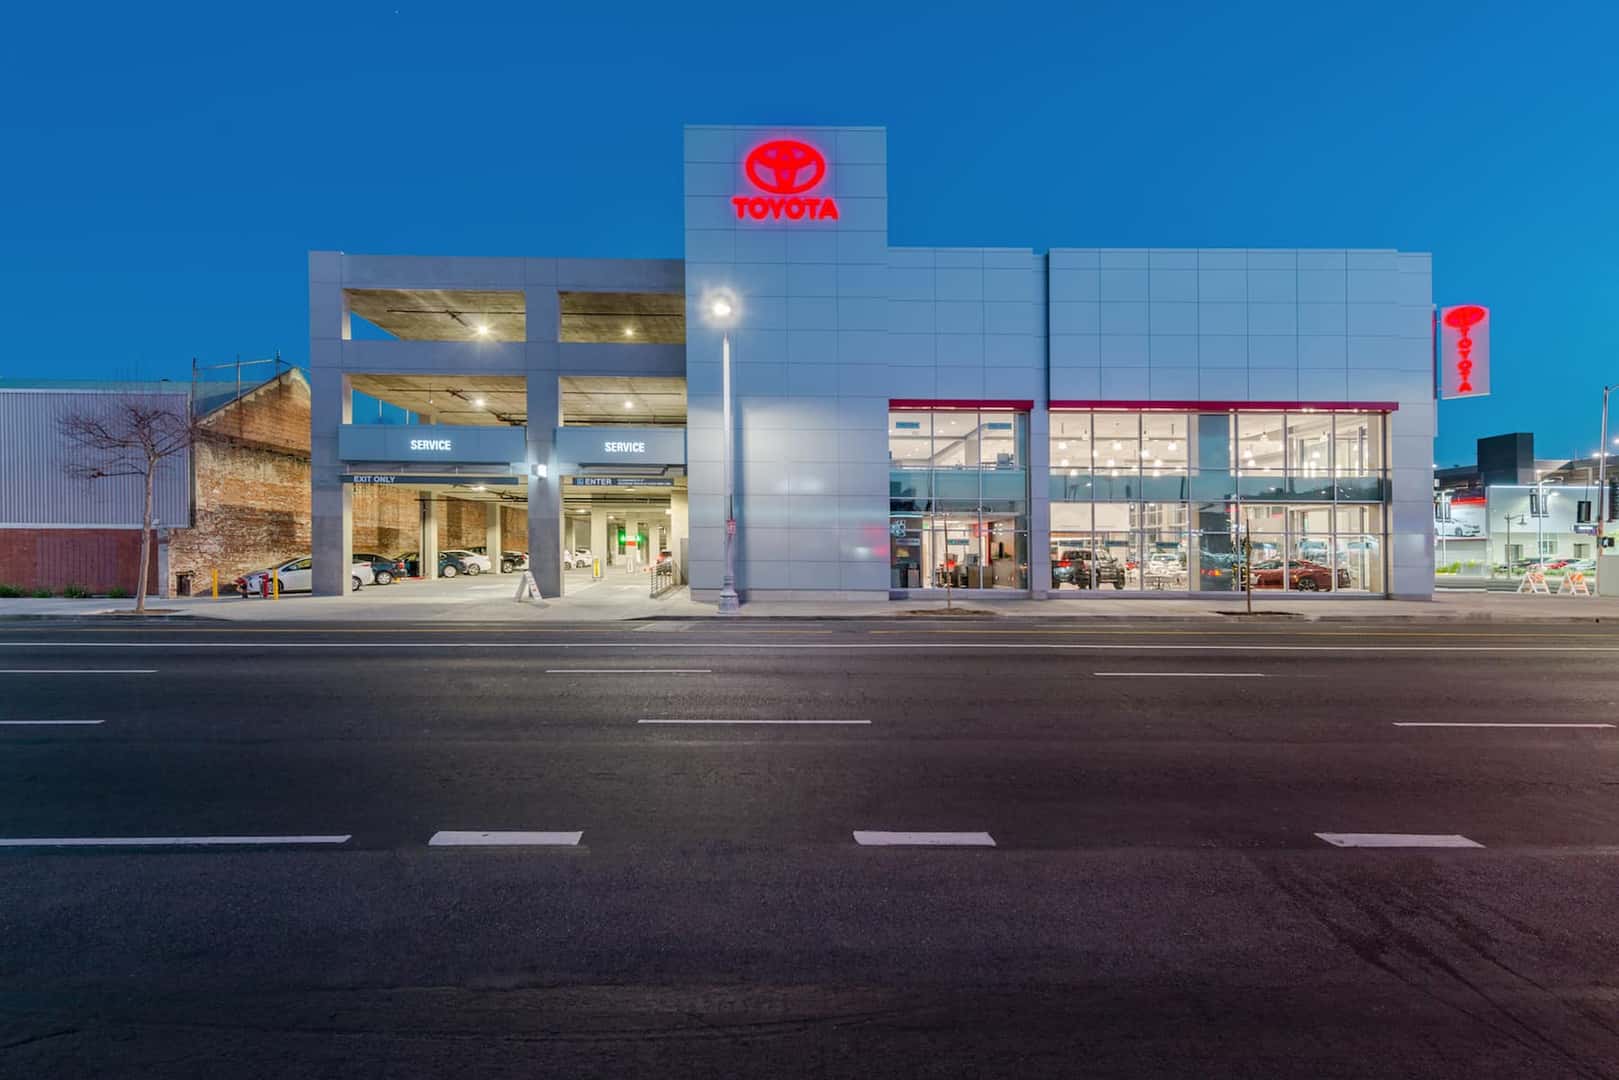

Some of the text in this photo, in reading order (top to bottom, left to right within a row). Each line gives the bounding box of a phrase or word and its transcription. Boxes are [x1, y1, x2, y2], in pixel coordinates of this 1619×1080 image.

[731, 196, 840, 221] TOYOTA
[1457, 327, 1473, 393] TOYOTA
[410, 439, 452, 451] SERVICE
[604, 441, 646, 453] SERVICE
[353, 475, 396, 483] EXIT ONLY
[585, 478, 612, 486] ENTER
